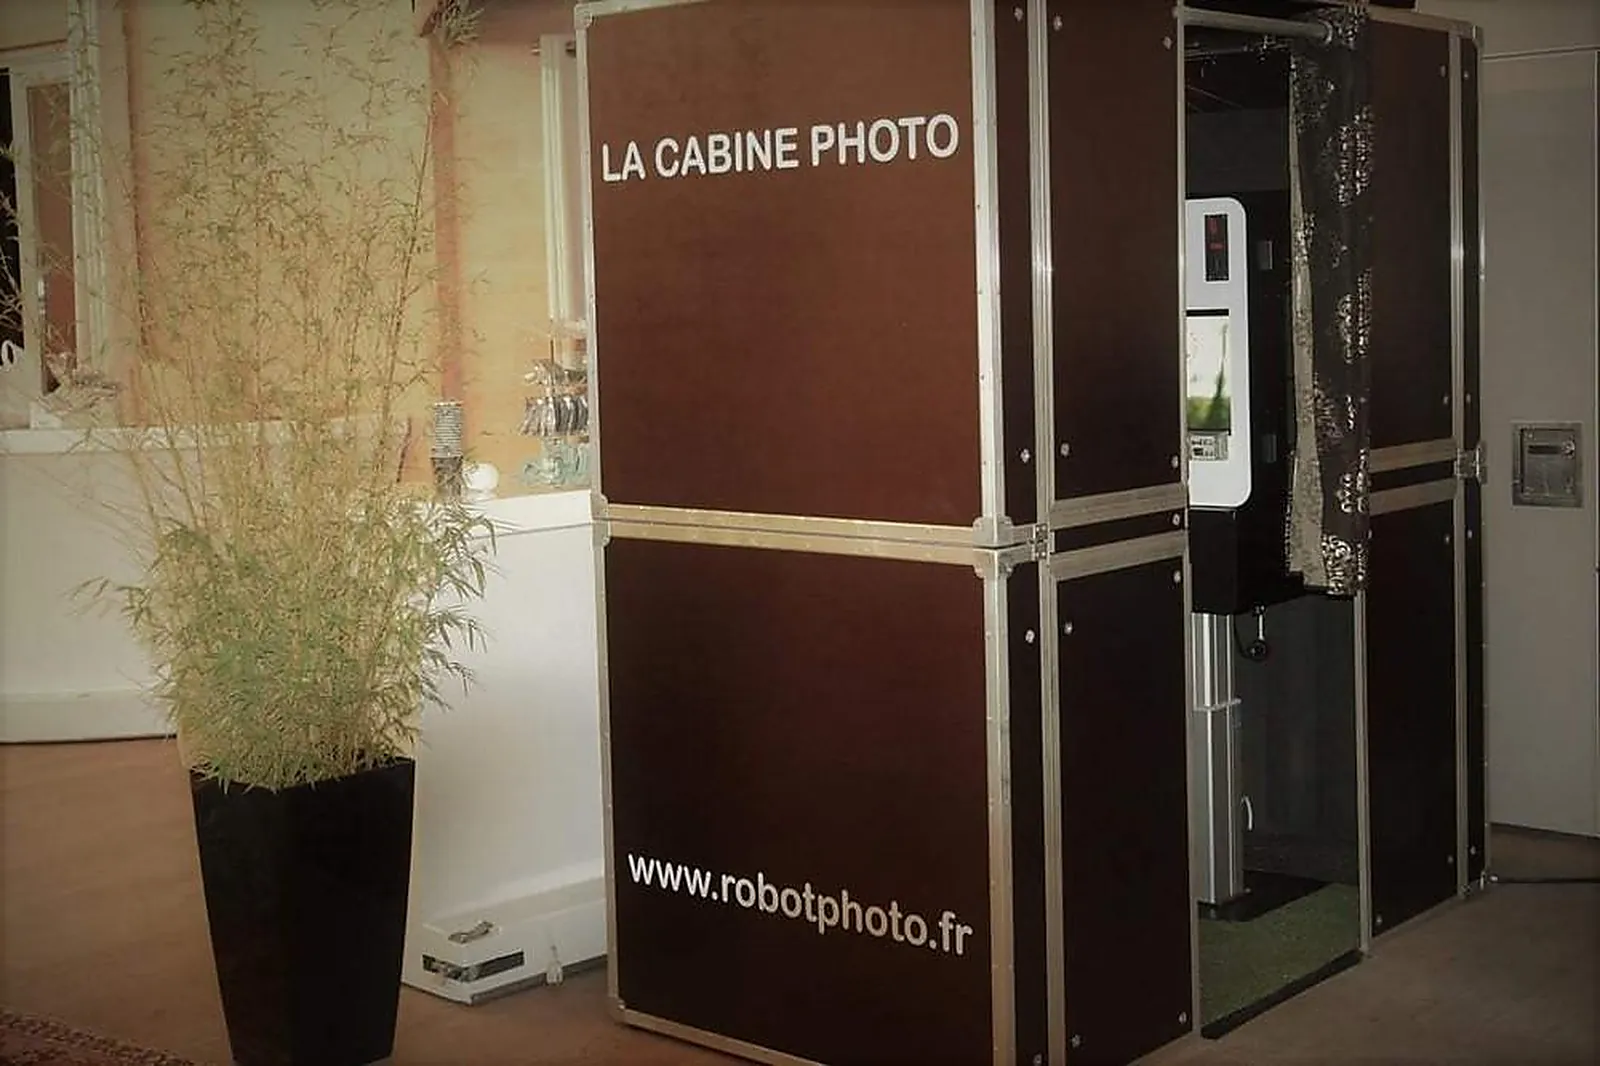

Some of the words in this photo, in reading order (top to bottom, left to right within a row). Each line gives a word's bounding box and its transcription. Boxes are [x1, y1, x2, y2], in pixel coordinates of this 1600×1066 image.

[603, 141, 646, 182] LA
[655, 126, 799, 178] CABINE
[810, 114, 959, 167] PHOTO
[627, 853, 973, 955] www.robotphoto.fr
